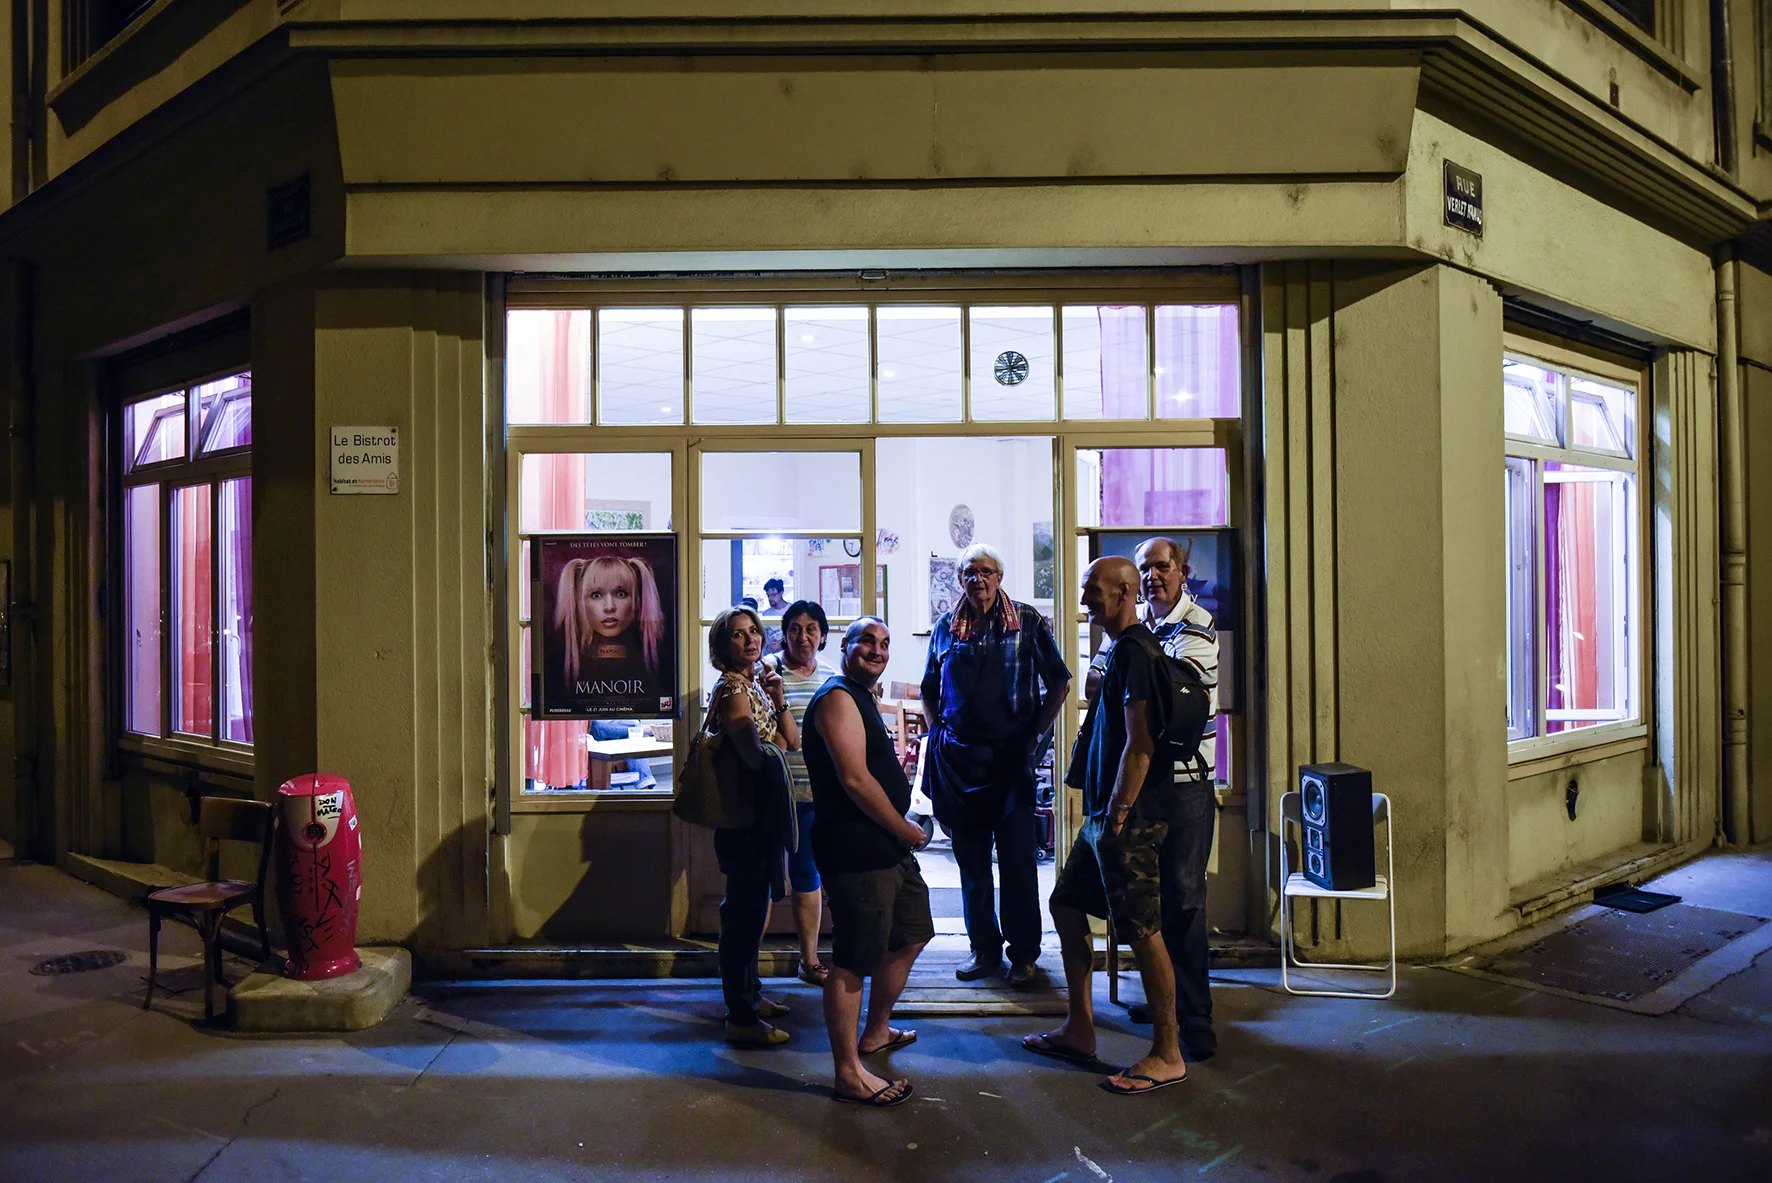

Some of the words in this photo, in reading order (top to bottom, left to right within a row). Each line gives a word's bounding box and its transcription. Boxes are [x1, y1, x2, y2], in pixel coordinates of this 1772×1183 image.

[1456, 175, 1476, 198] RUE
[334, 434, 348, 446] Le
[353, 434, 396, 446] Bistrot
[338, 452, 360, 464] des
[361, 452, 392, 464] Amis
[576, 679, 645, 694] MANOIR
[318, 796, 337, 806] DON
